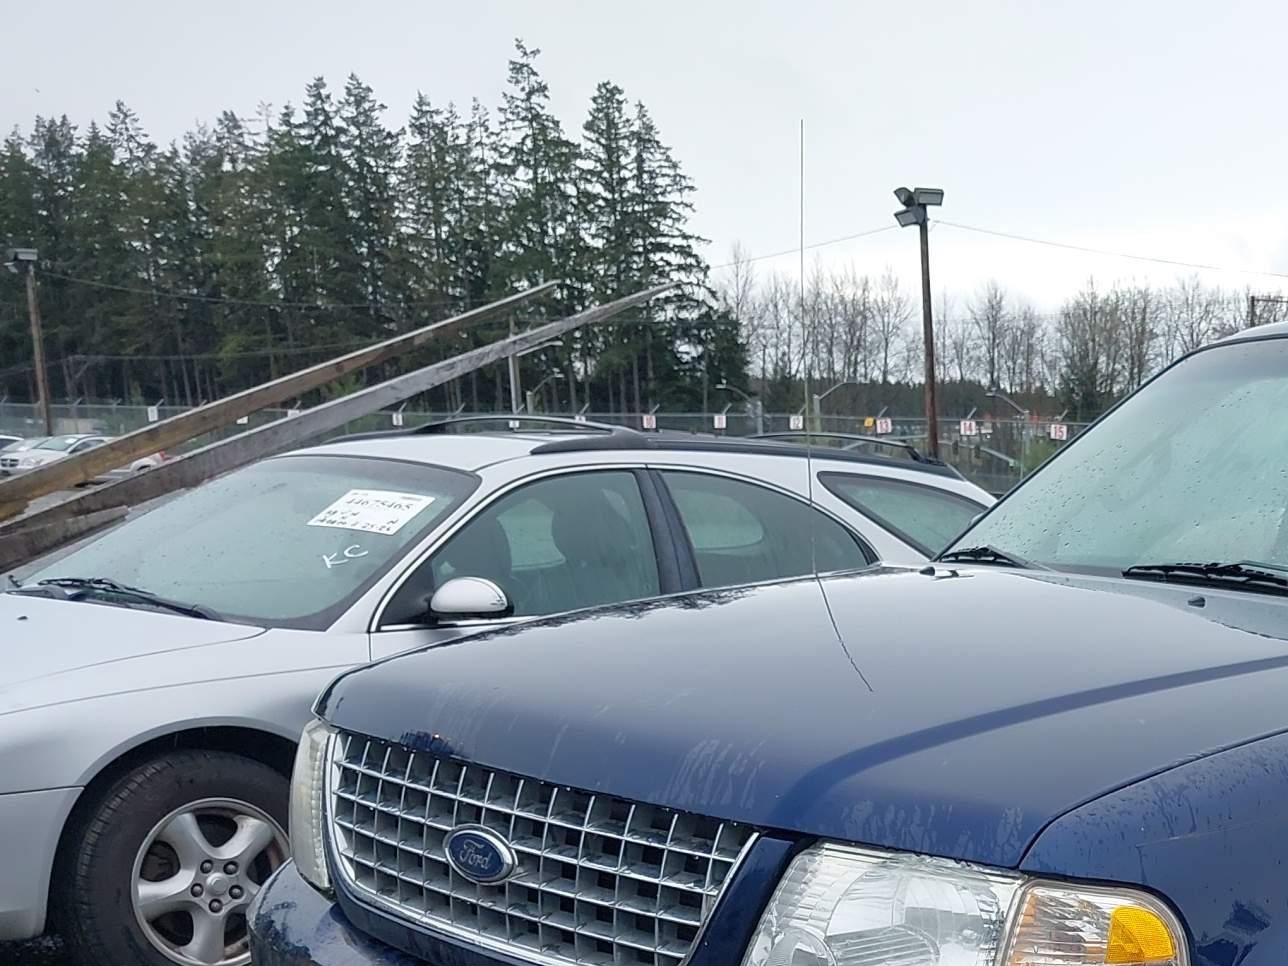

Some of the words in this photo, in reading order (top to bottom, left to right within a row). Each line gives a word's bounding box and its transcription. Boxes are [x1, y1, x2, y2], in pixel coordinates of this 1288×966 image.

[963, 421, 974, 433] 14
[1054, 424, 1065, 438] 15
[322, 544, 369, 569] KC
[459, 839, 493, 870] Ford
